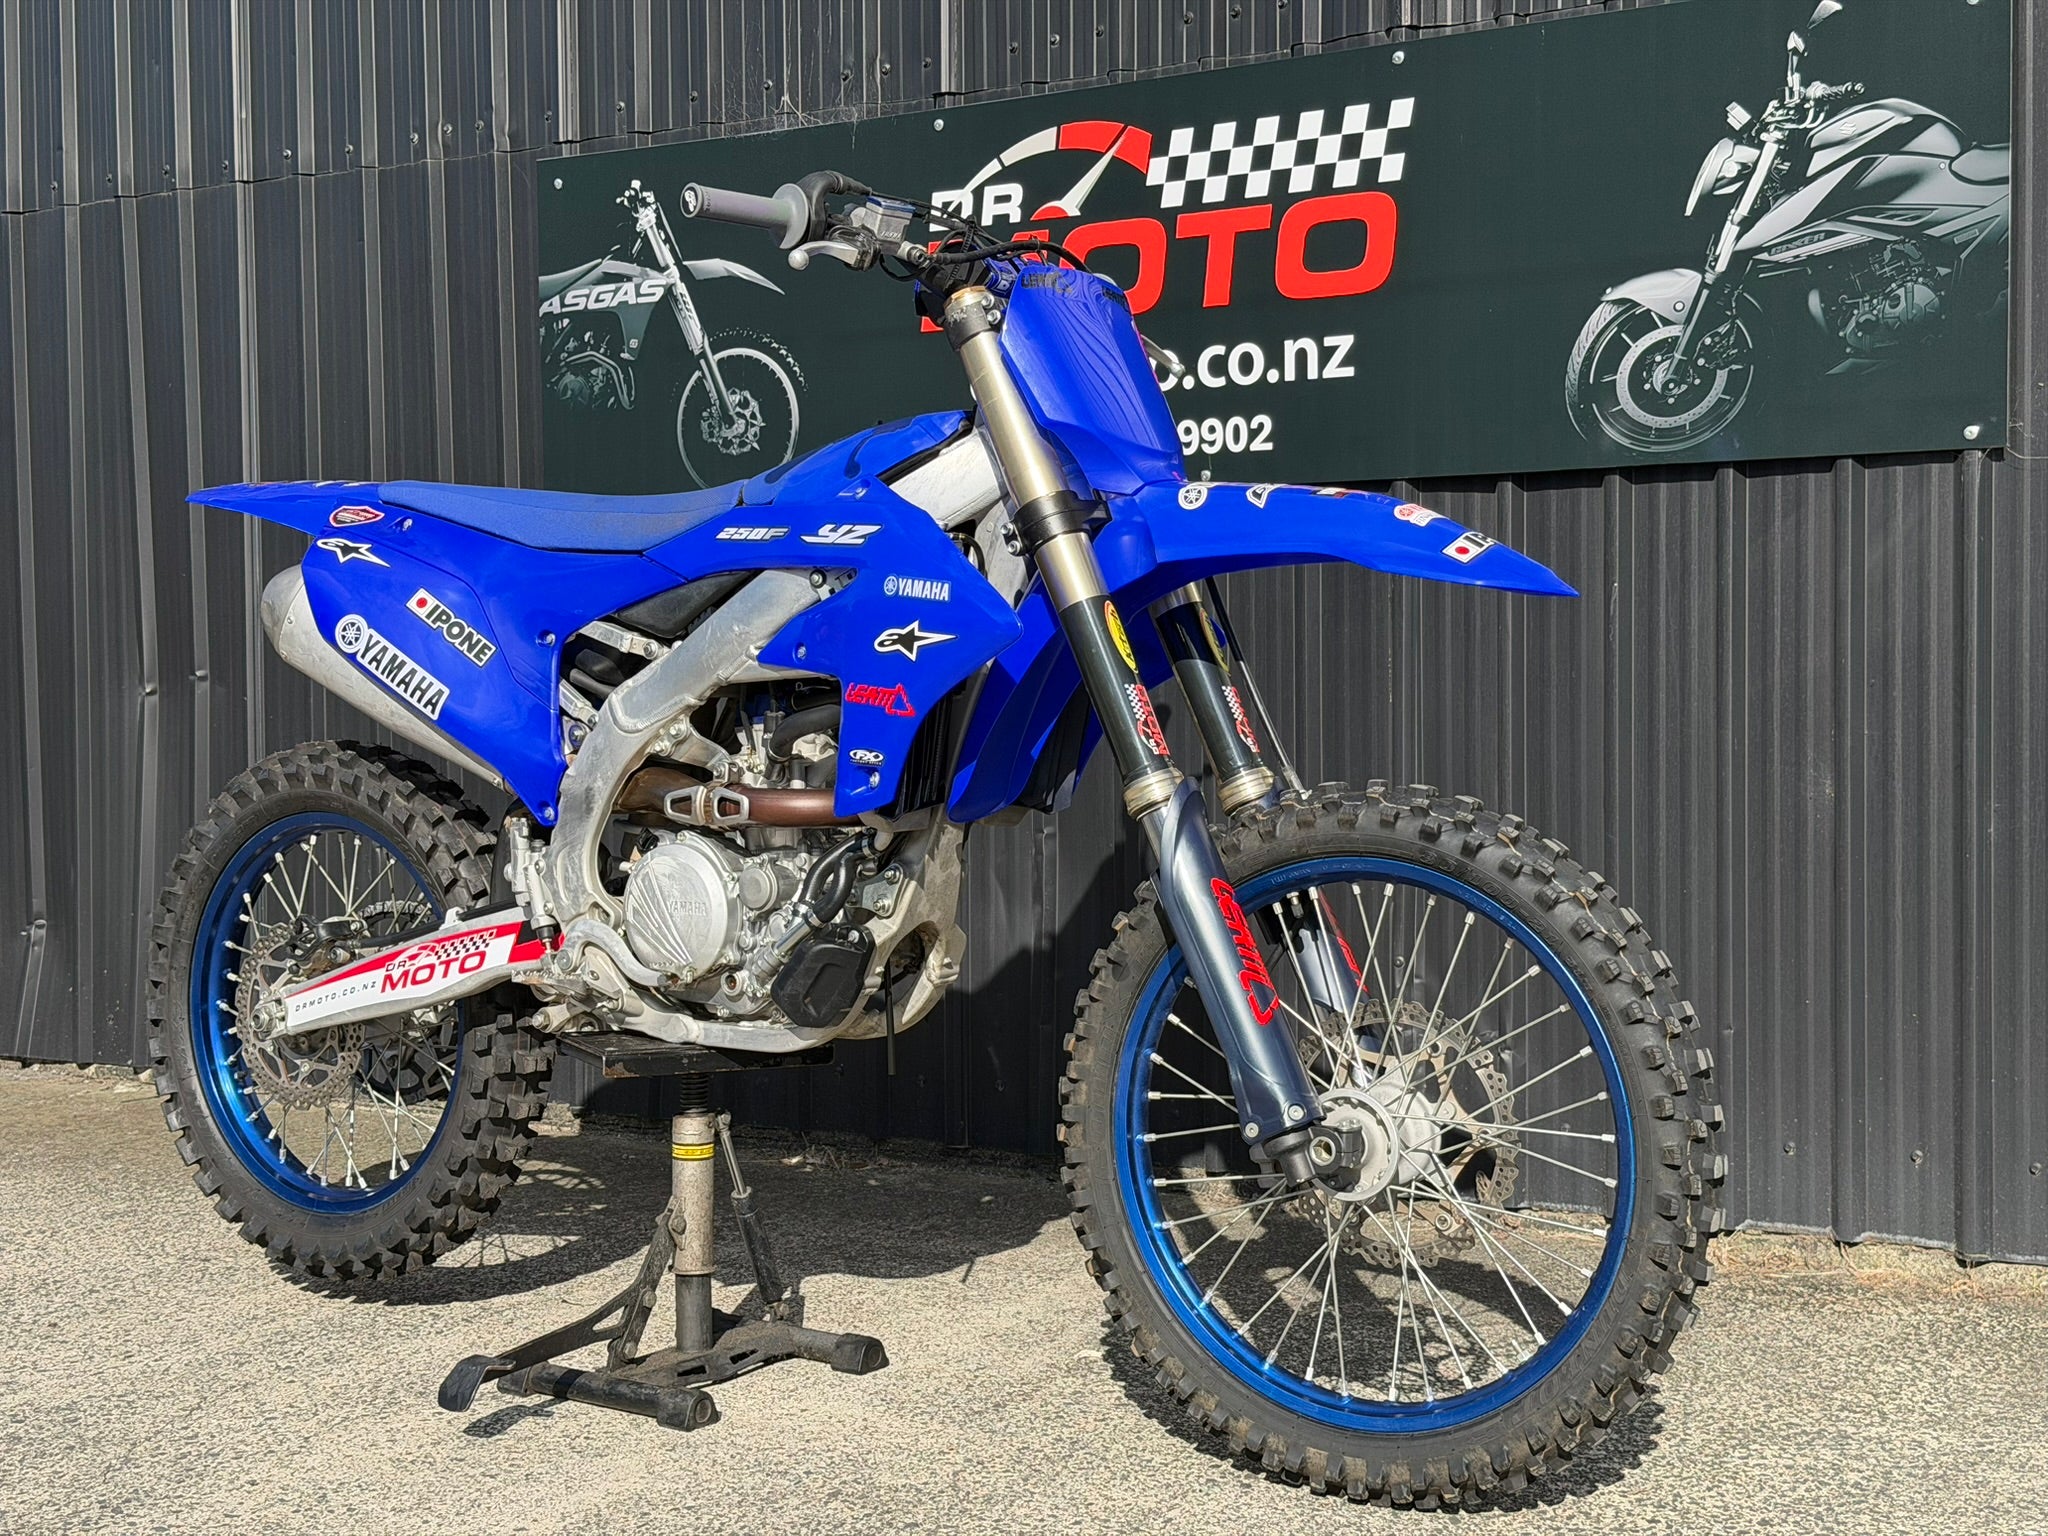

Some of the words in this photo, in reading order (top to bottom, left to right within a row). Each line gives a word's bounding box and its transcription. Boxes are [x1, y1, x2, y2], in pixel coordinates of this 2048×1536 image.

[920, 191, 1397, 333] OTO
[1176, 414, 1274, 456] 9902
[715, 527, 789, 540] 250F
[800, 523, 882, 544] YZ
[898, 577, 950, 601] YAMAHA
[424, 603, 493, 664] IPONE
[360, 633, 445, 716] YAMAHA
[668, 900, 708, 916] YAMAHA
[380, 950, 487, 994] MOTO
[385, 960, 407, 973] DR
[295, 981, 377, 1012] DRMOTO.CO.NZ
